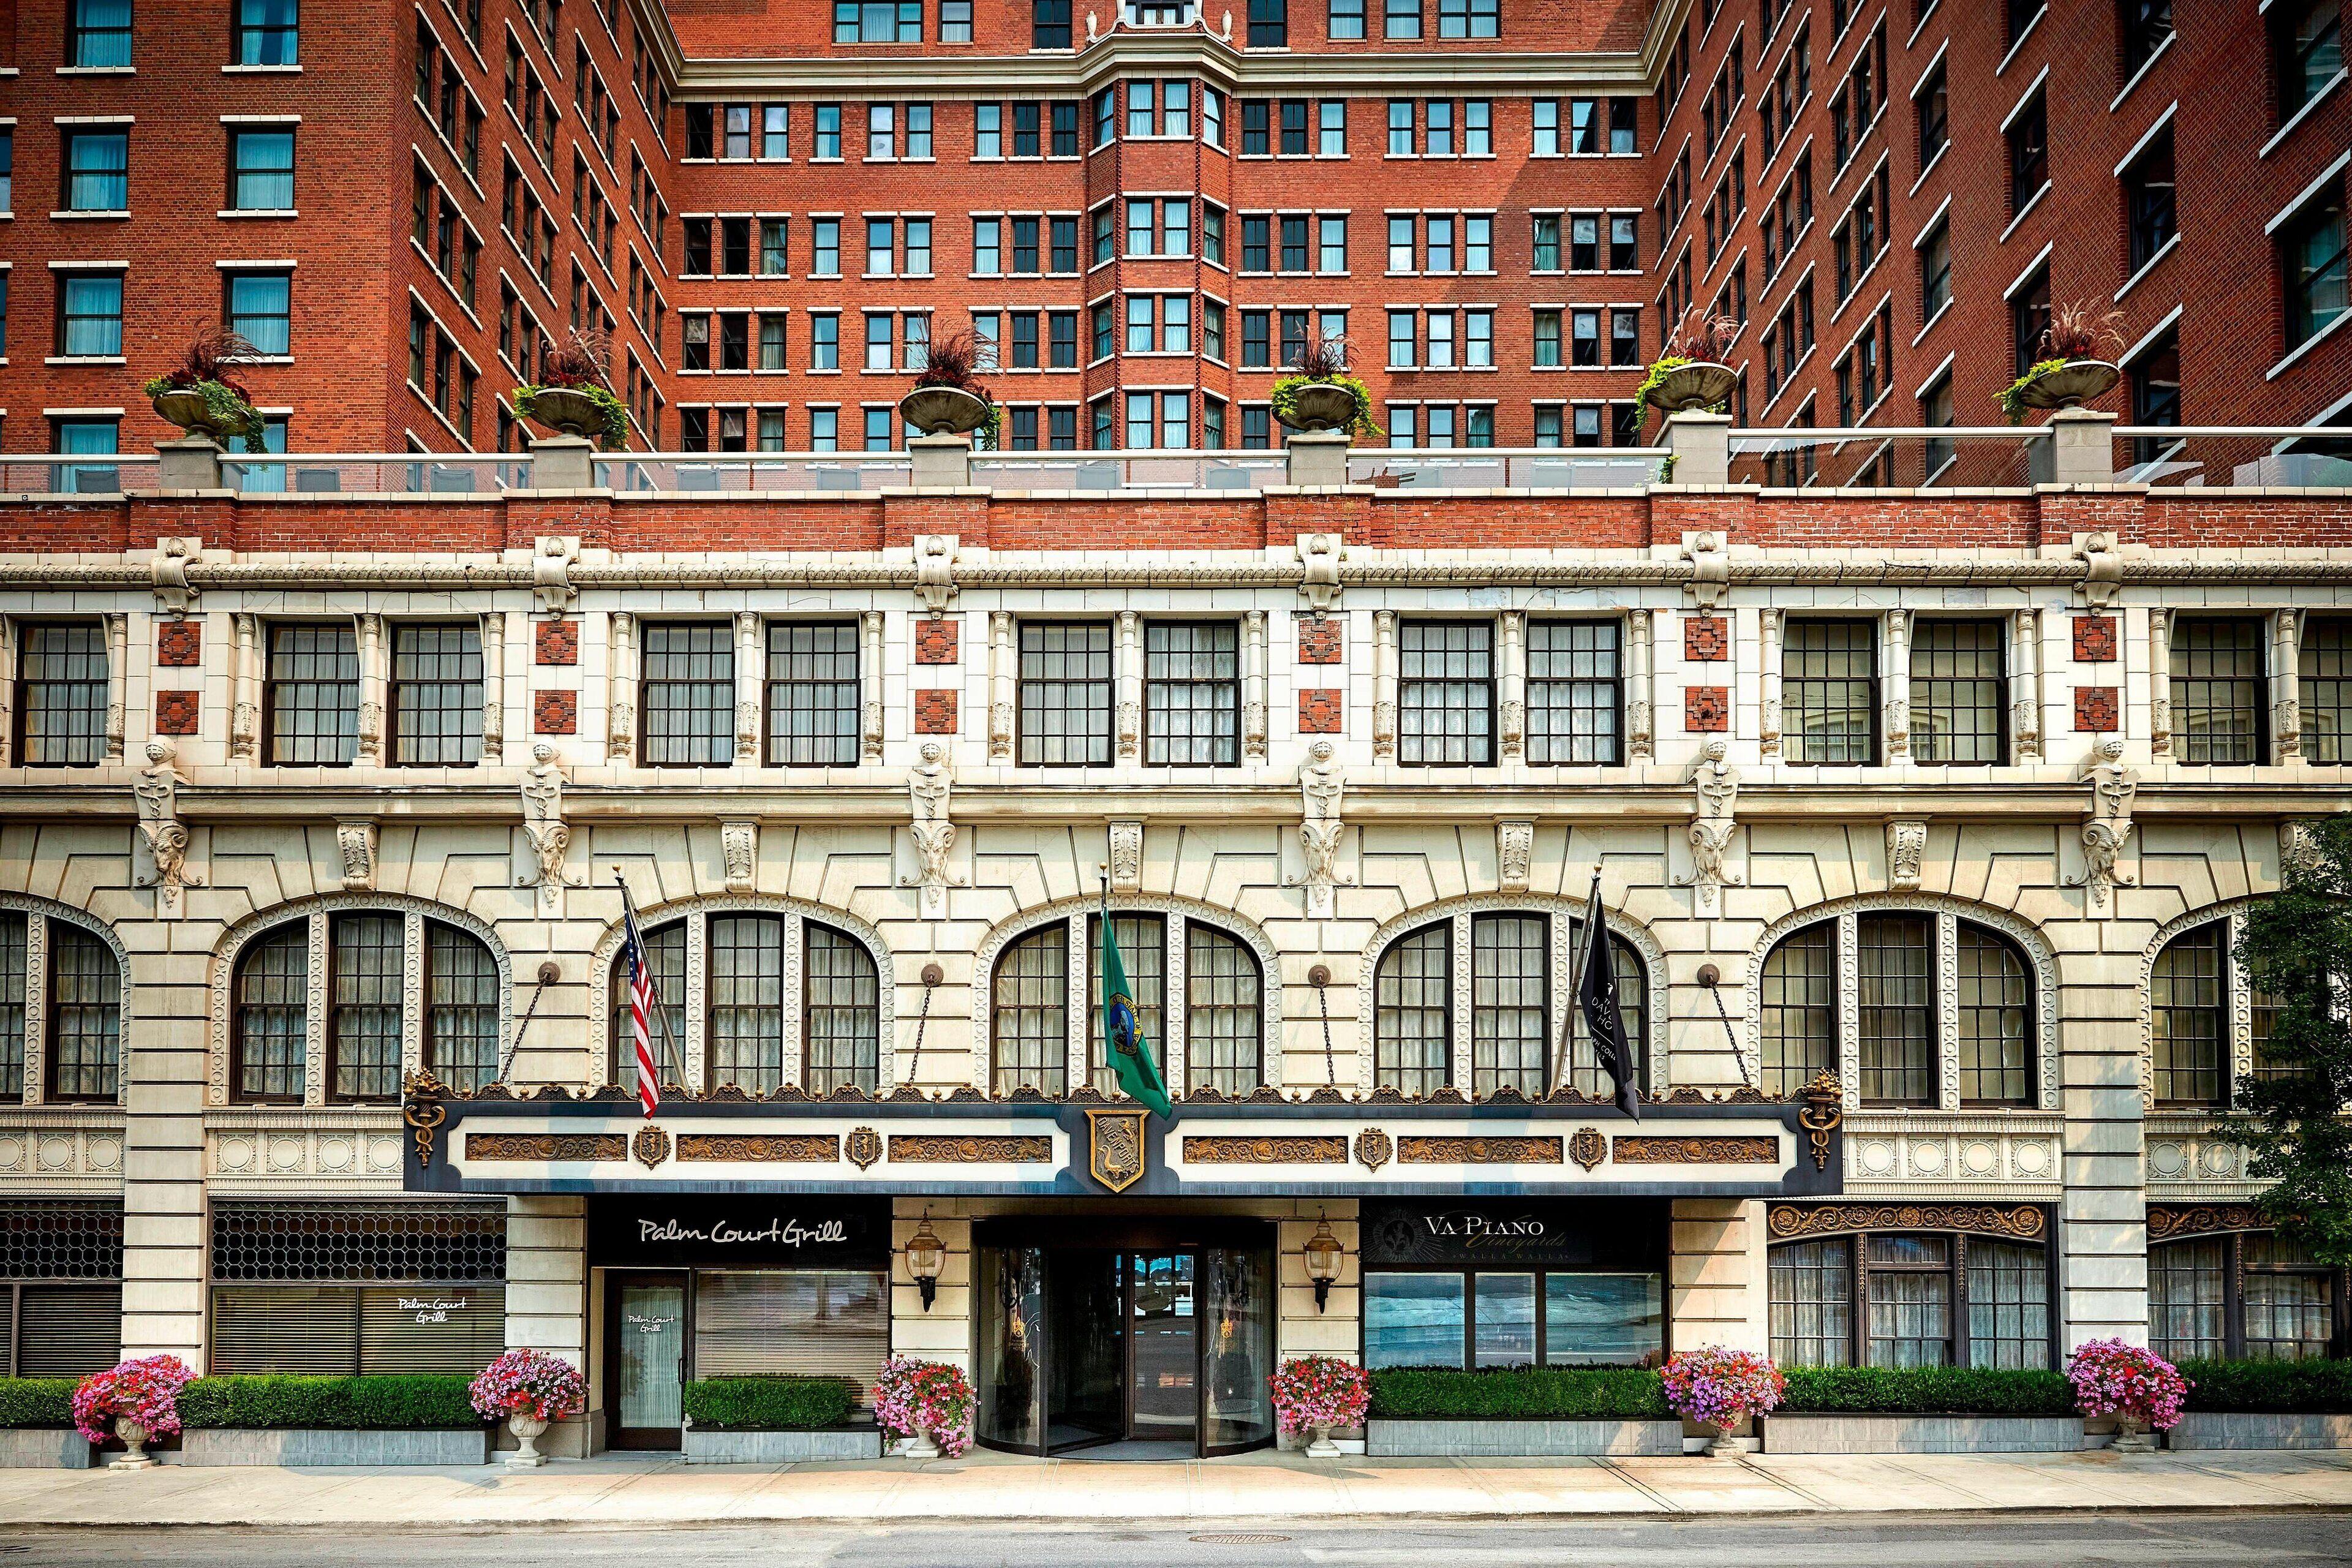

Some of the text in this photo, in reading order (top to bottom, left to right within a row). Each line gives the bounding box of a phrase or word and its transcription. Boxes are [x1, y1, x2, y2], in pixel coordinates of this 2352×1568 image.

[638, 1218, 847, 1248] Palm Court Grill
[398, 1296, 467, 1310] Palm Court
[416, 1310, 448, 1325] Grill
[628, 1314, 675, 1324] Palm Court
[640, 1324, 662, 1333] Grill
